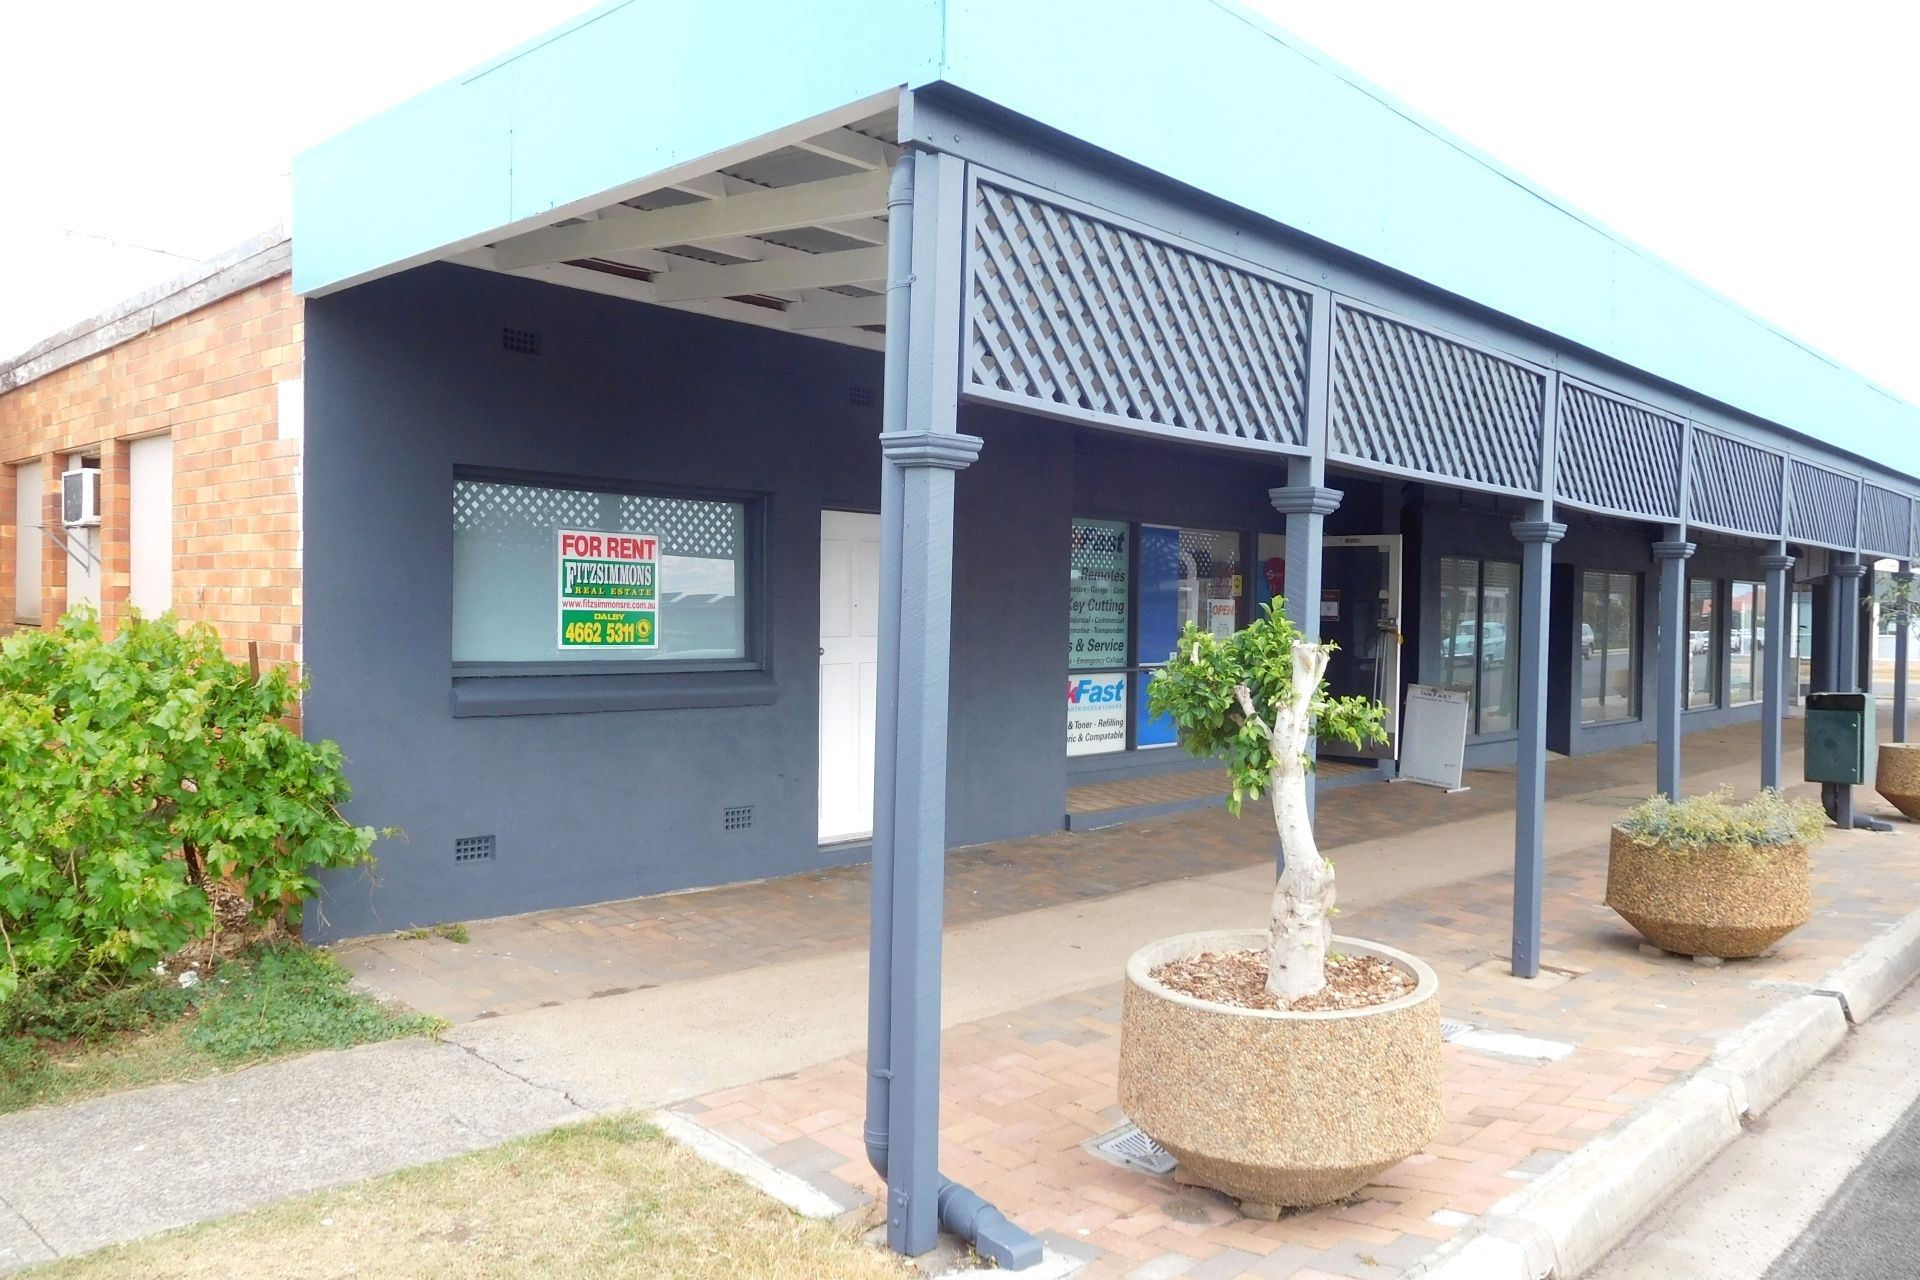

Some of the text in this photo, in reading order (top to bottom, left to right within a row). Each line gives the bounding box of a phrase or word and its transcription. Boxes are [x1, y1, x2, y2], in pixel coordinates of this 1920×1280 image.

[562, 534, 656, 560] FOR RENT
[564, 561, 652, 594] FITZSIMMONS
[1081, 567, 1125, 582] Remotes
[575, 586, 652, 596] REAL ESTATE
[562, 599, 656, 610] www.fitzsimmonsre.com.au
[1088, 598, 1125, 615] Cutting
[1212, 604, 1235, 616] OPEN
[594, 613, 626, 621] DALBY
[1095, 616, 1125, 624] Commercial
[566, 622, 635, 643] 4662 5311
[1075, 638, 1084, 652] &
[1087, 638, 1124, 652] Service
[1077, 657, 1105, 665] Emergency
[1067, 720, 1074, 730] &
[1075, 720, 1093, 729] Toner
[1097, 718, 1124, 728] Refilling
[1078, 733, 1084, 742] &
[1085, 730, 1124, 742] Compatable
